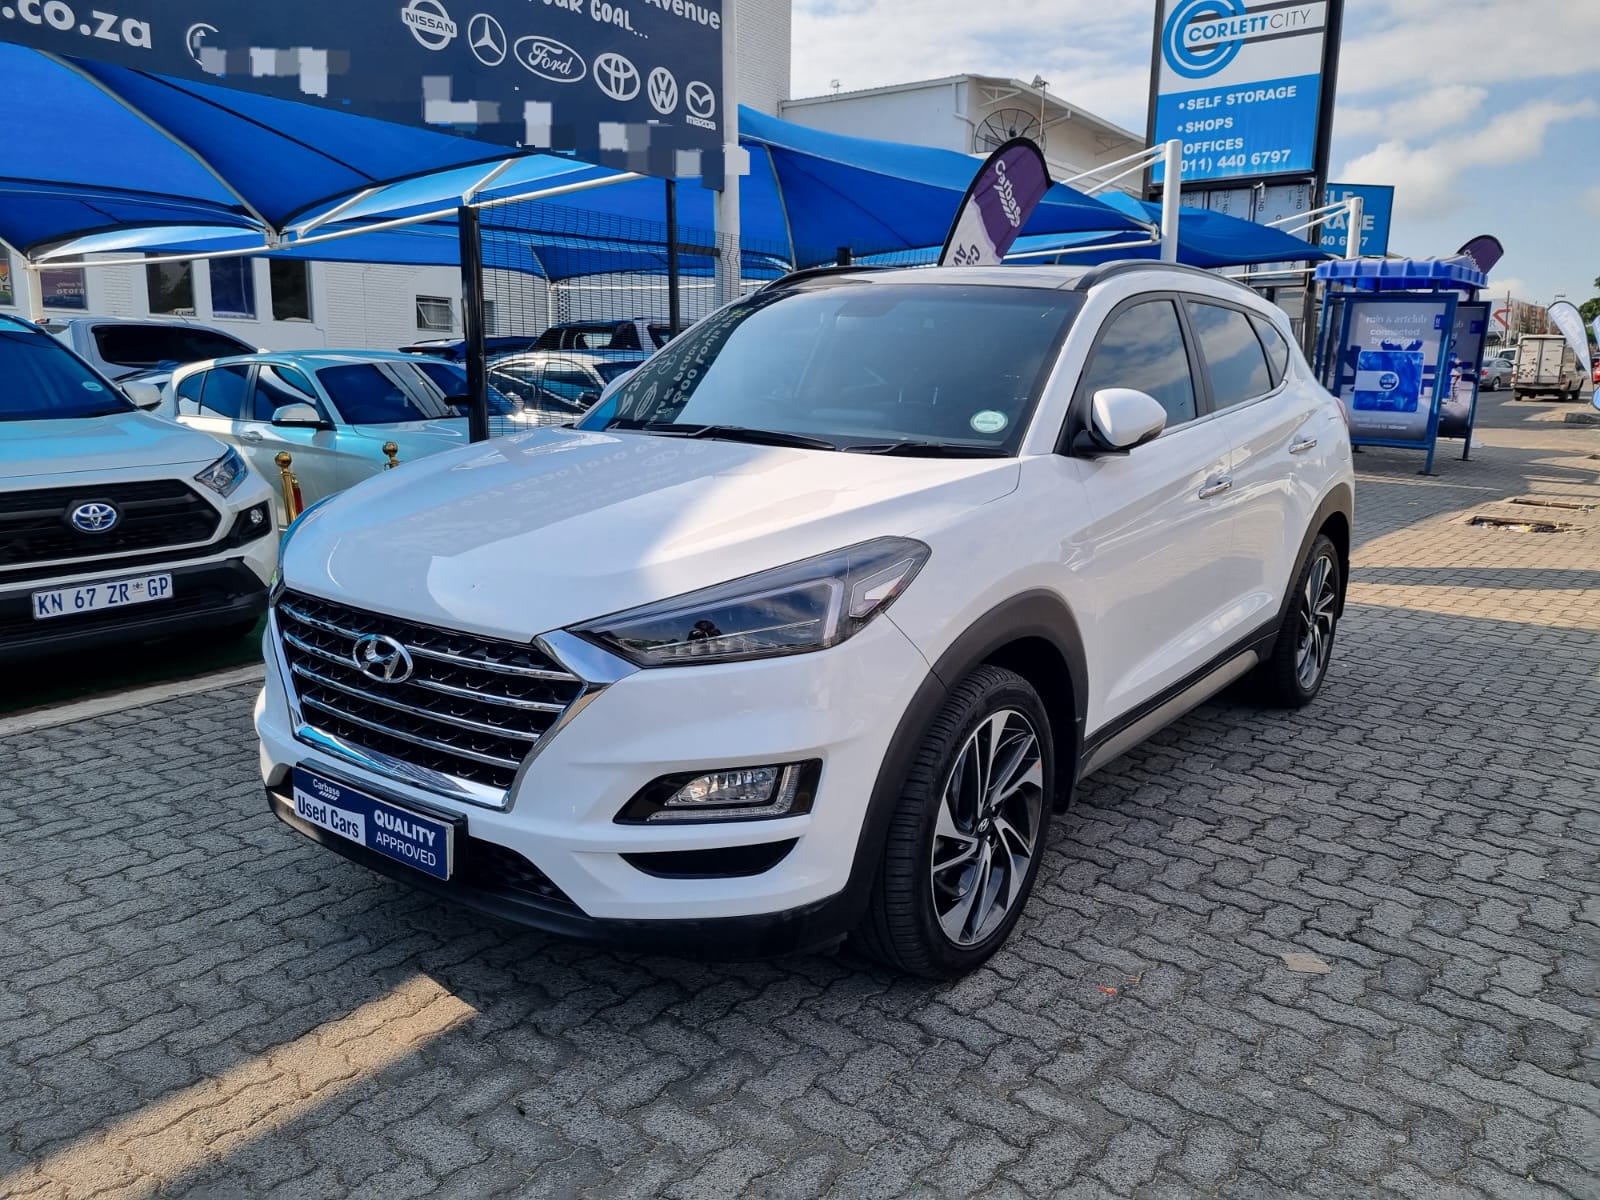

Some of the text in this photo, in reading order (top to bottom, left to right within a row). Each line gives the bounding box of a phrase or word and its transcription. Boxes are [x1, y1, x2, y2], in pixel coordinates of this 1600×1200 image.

[405, 12, 455, 34] NISSAN
[528, 41, 574, 75] Ford
[1186, 85, 1297, 111] SELF STORAGE
[686, 114, 717, 131] mazda
[1185, 117, 1234, 133] SHOPS
[1183, 137, 1244, 155] OFFICES
[1217, 154, 1246, 169] 440
[1251, 149, 1291, 166] 6797
[1370, 328, 1421, 337] connected
[1370, 336, 1417, 347] by design
[37, 577, 169, 615] KN 67 ZR GP
[312, 778, 341, 798] Carbase
[297, 795, 360, 838] Used Cars
[373, 809, 437, 847] QUALITY
[375, 831, 437, 867] APPROVED
